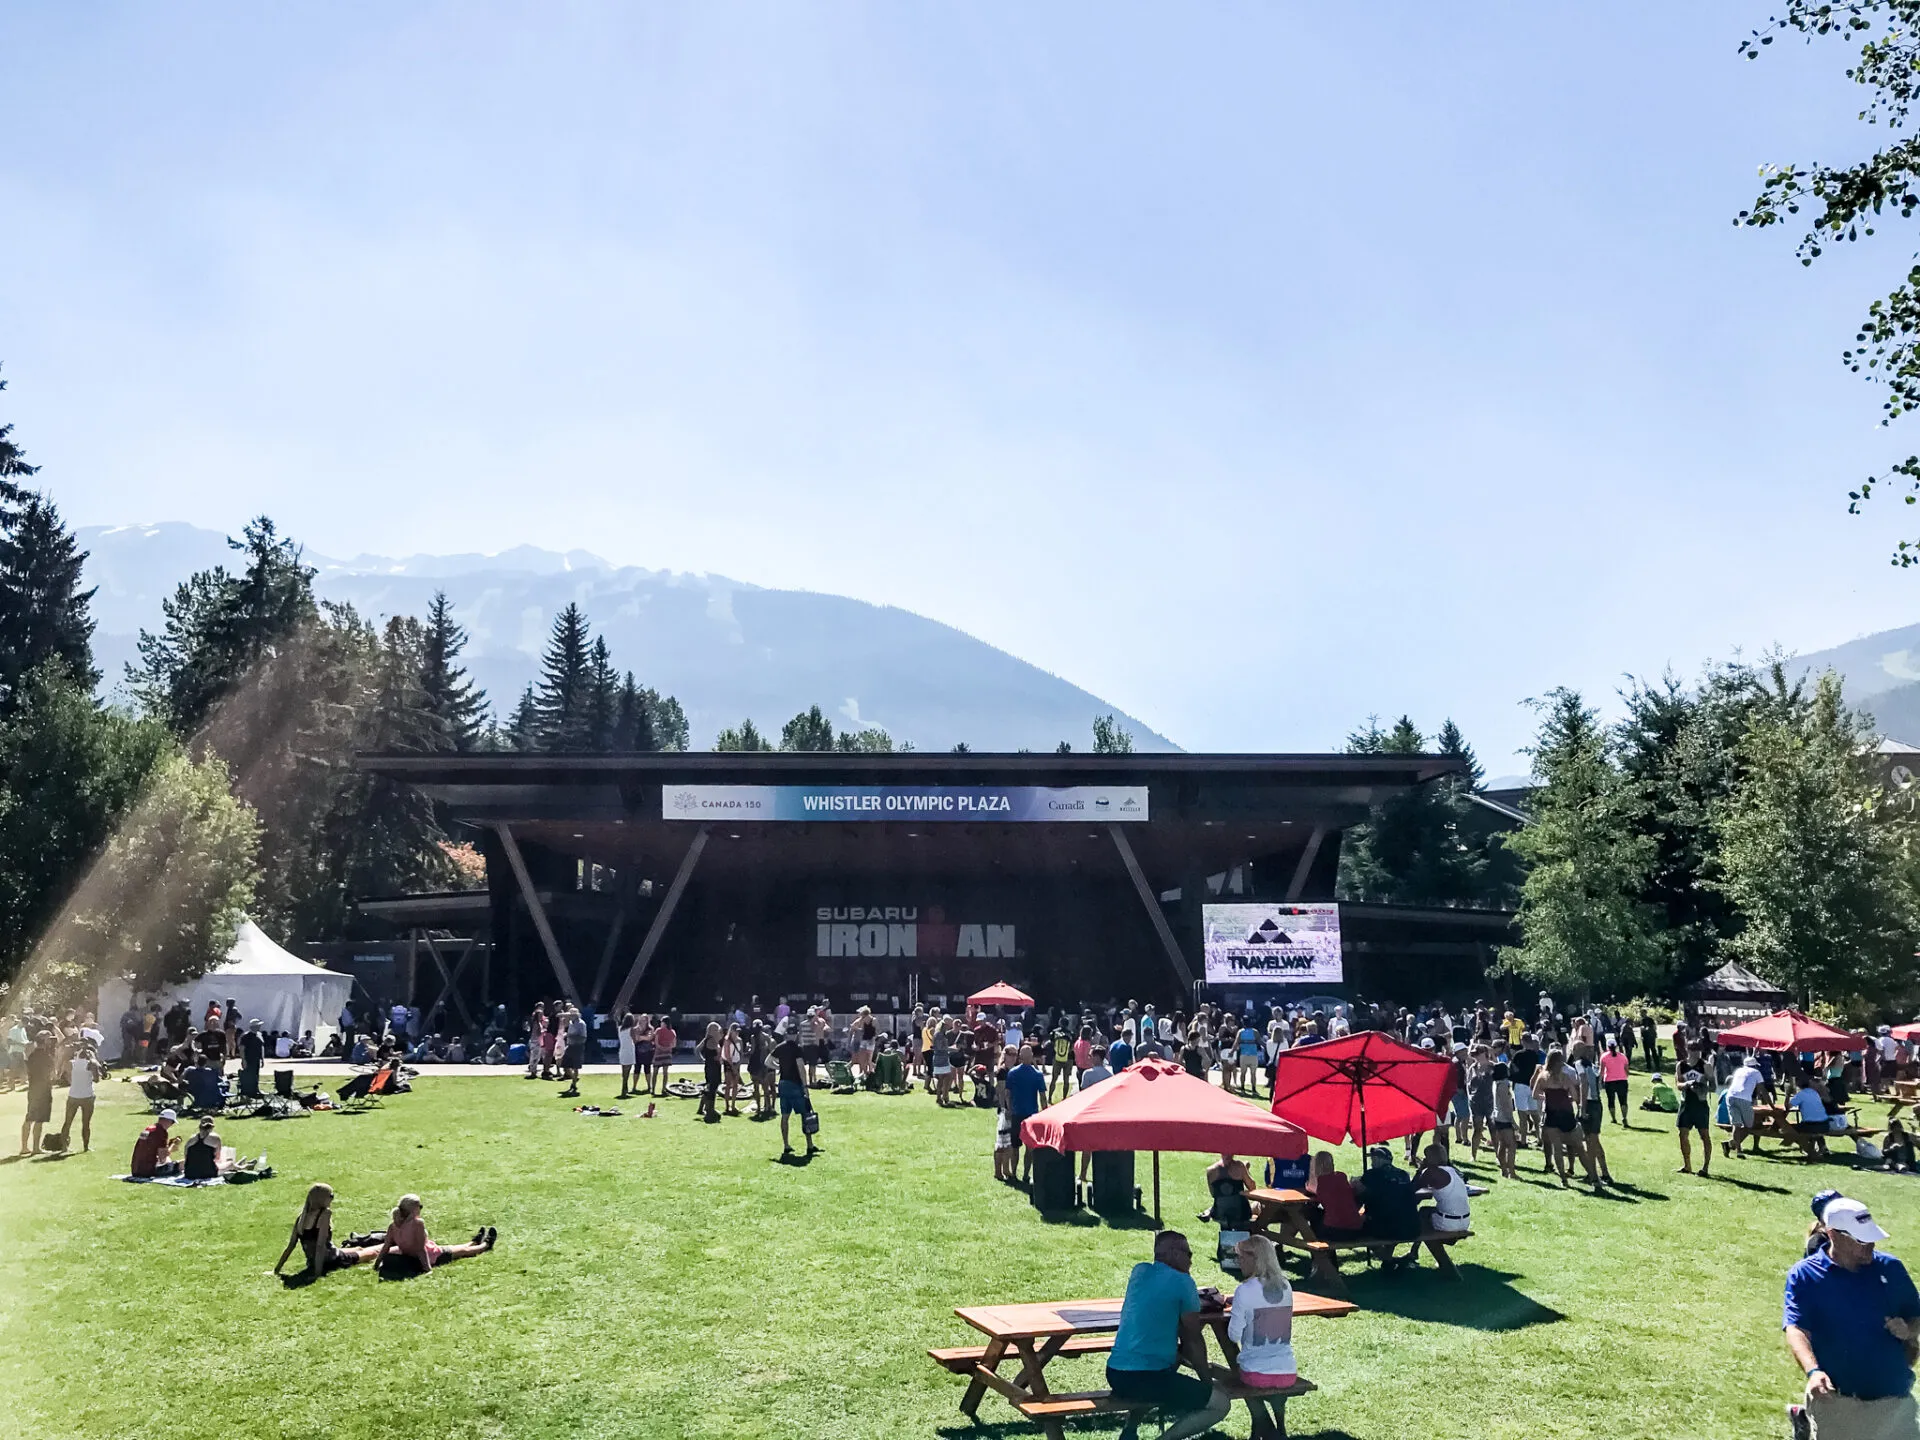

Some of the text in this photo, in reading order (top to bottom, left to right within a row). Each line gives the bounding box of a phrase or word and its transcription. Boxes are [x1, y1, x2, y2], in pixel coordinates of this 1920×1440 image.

[701, 800, 742, 808] CANADA
[803, 795, 1011, 811] WHISTLER OLYMPIC PLAZA
[1048, 800, 1085, 810] Canada
[816, 907, 918, 920] SUBARU
[1227, 955, 1315, 970] TRAVELWAY
[1697, 1005, 1773, 1018] LifeSport
